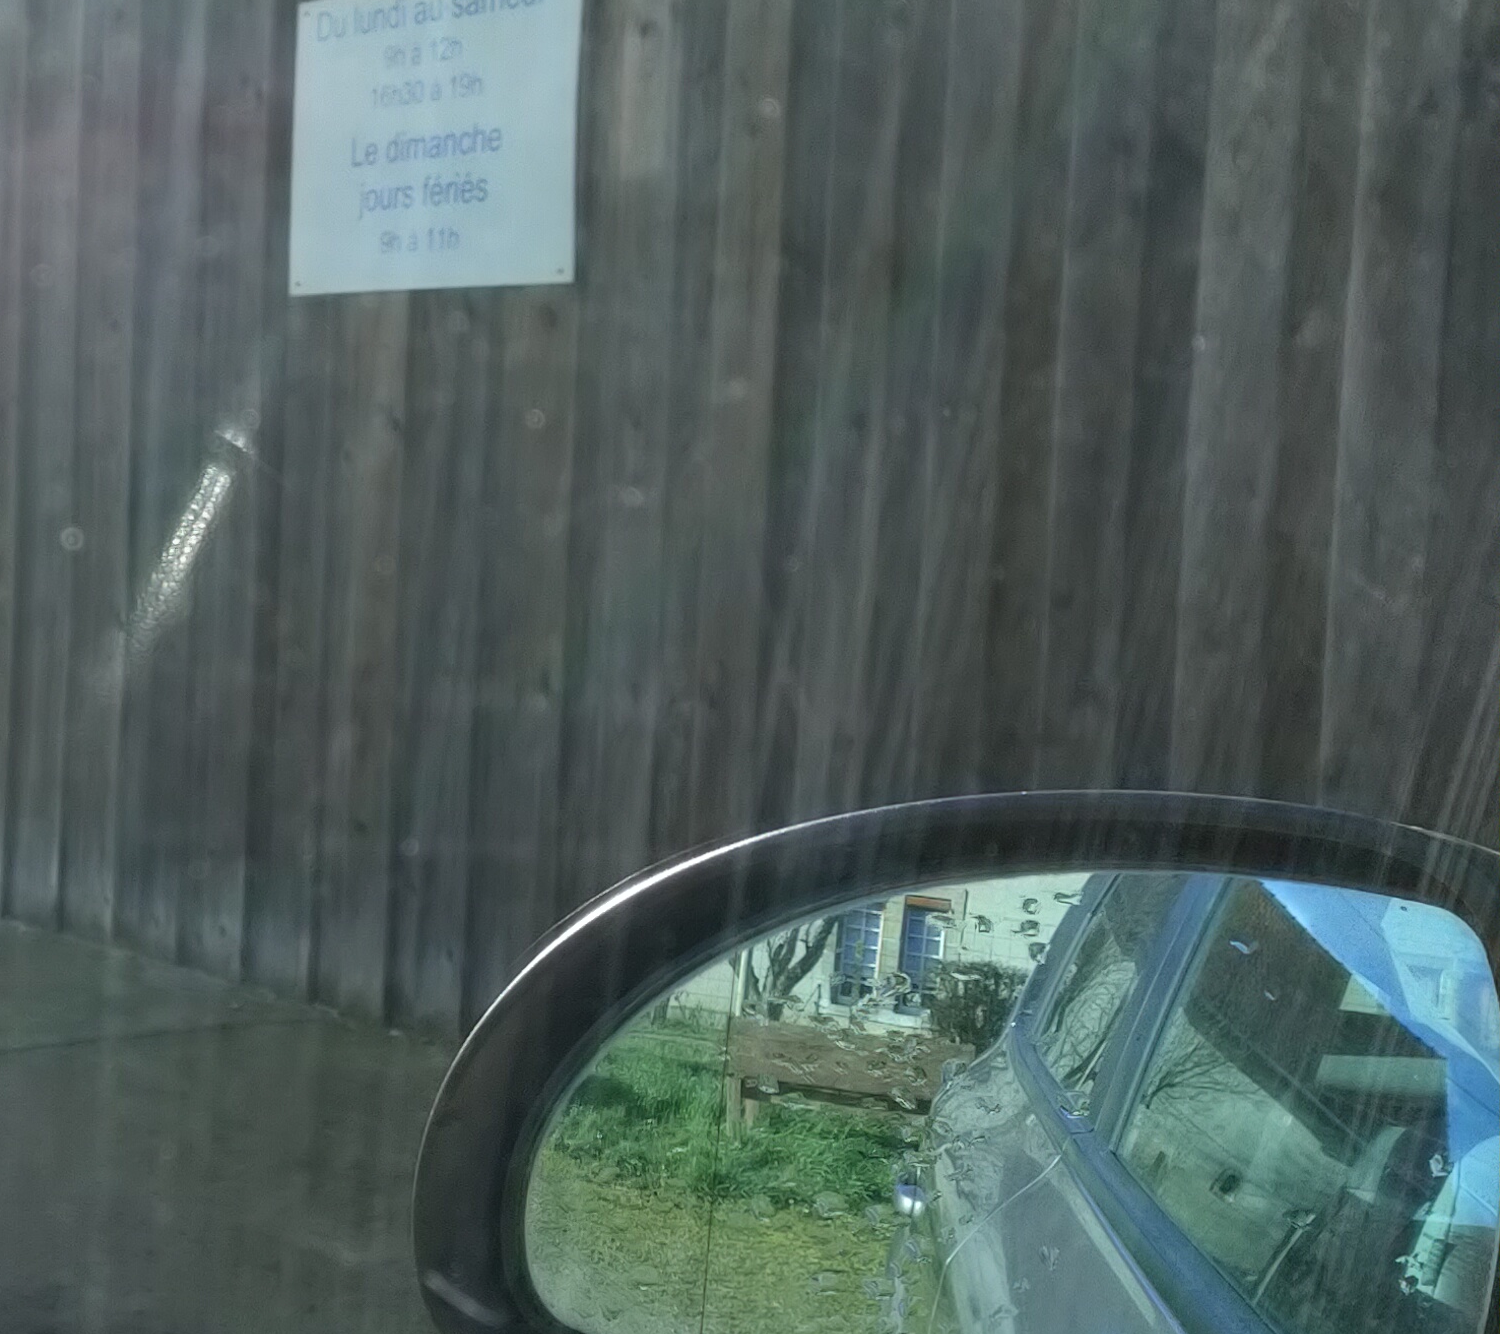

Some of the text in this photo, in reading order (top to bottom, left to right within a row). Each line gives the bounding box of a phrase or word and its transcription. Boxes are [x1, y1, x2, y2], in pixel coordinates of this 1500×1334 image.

[316, 10, 347, 43] Du
[353, 1, 407, 35] lundi
[351, 122, 503, 169] Le dimanche
[359, 170, 489, 221] jours fériés
